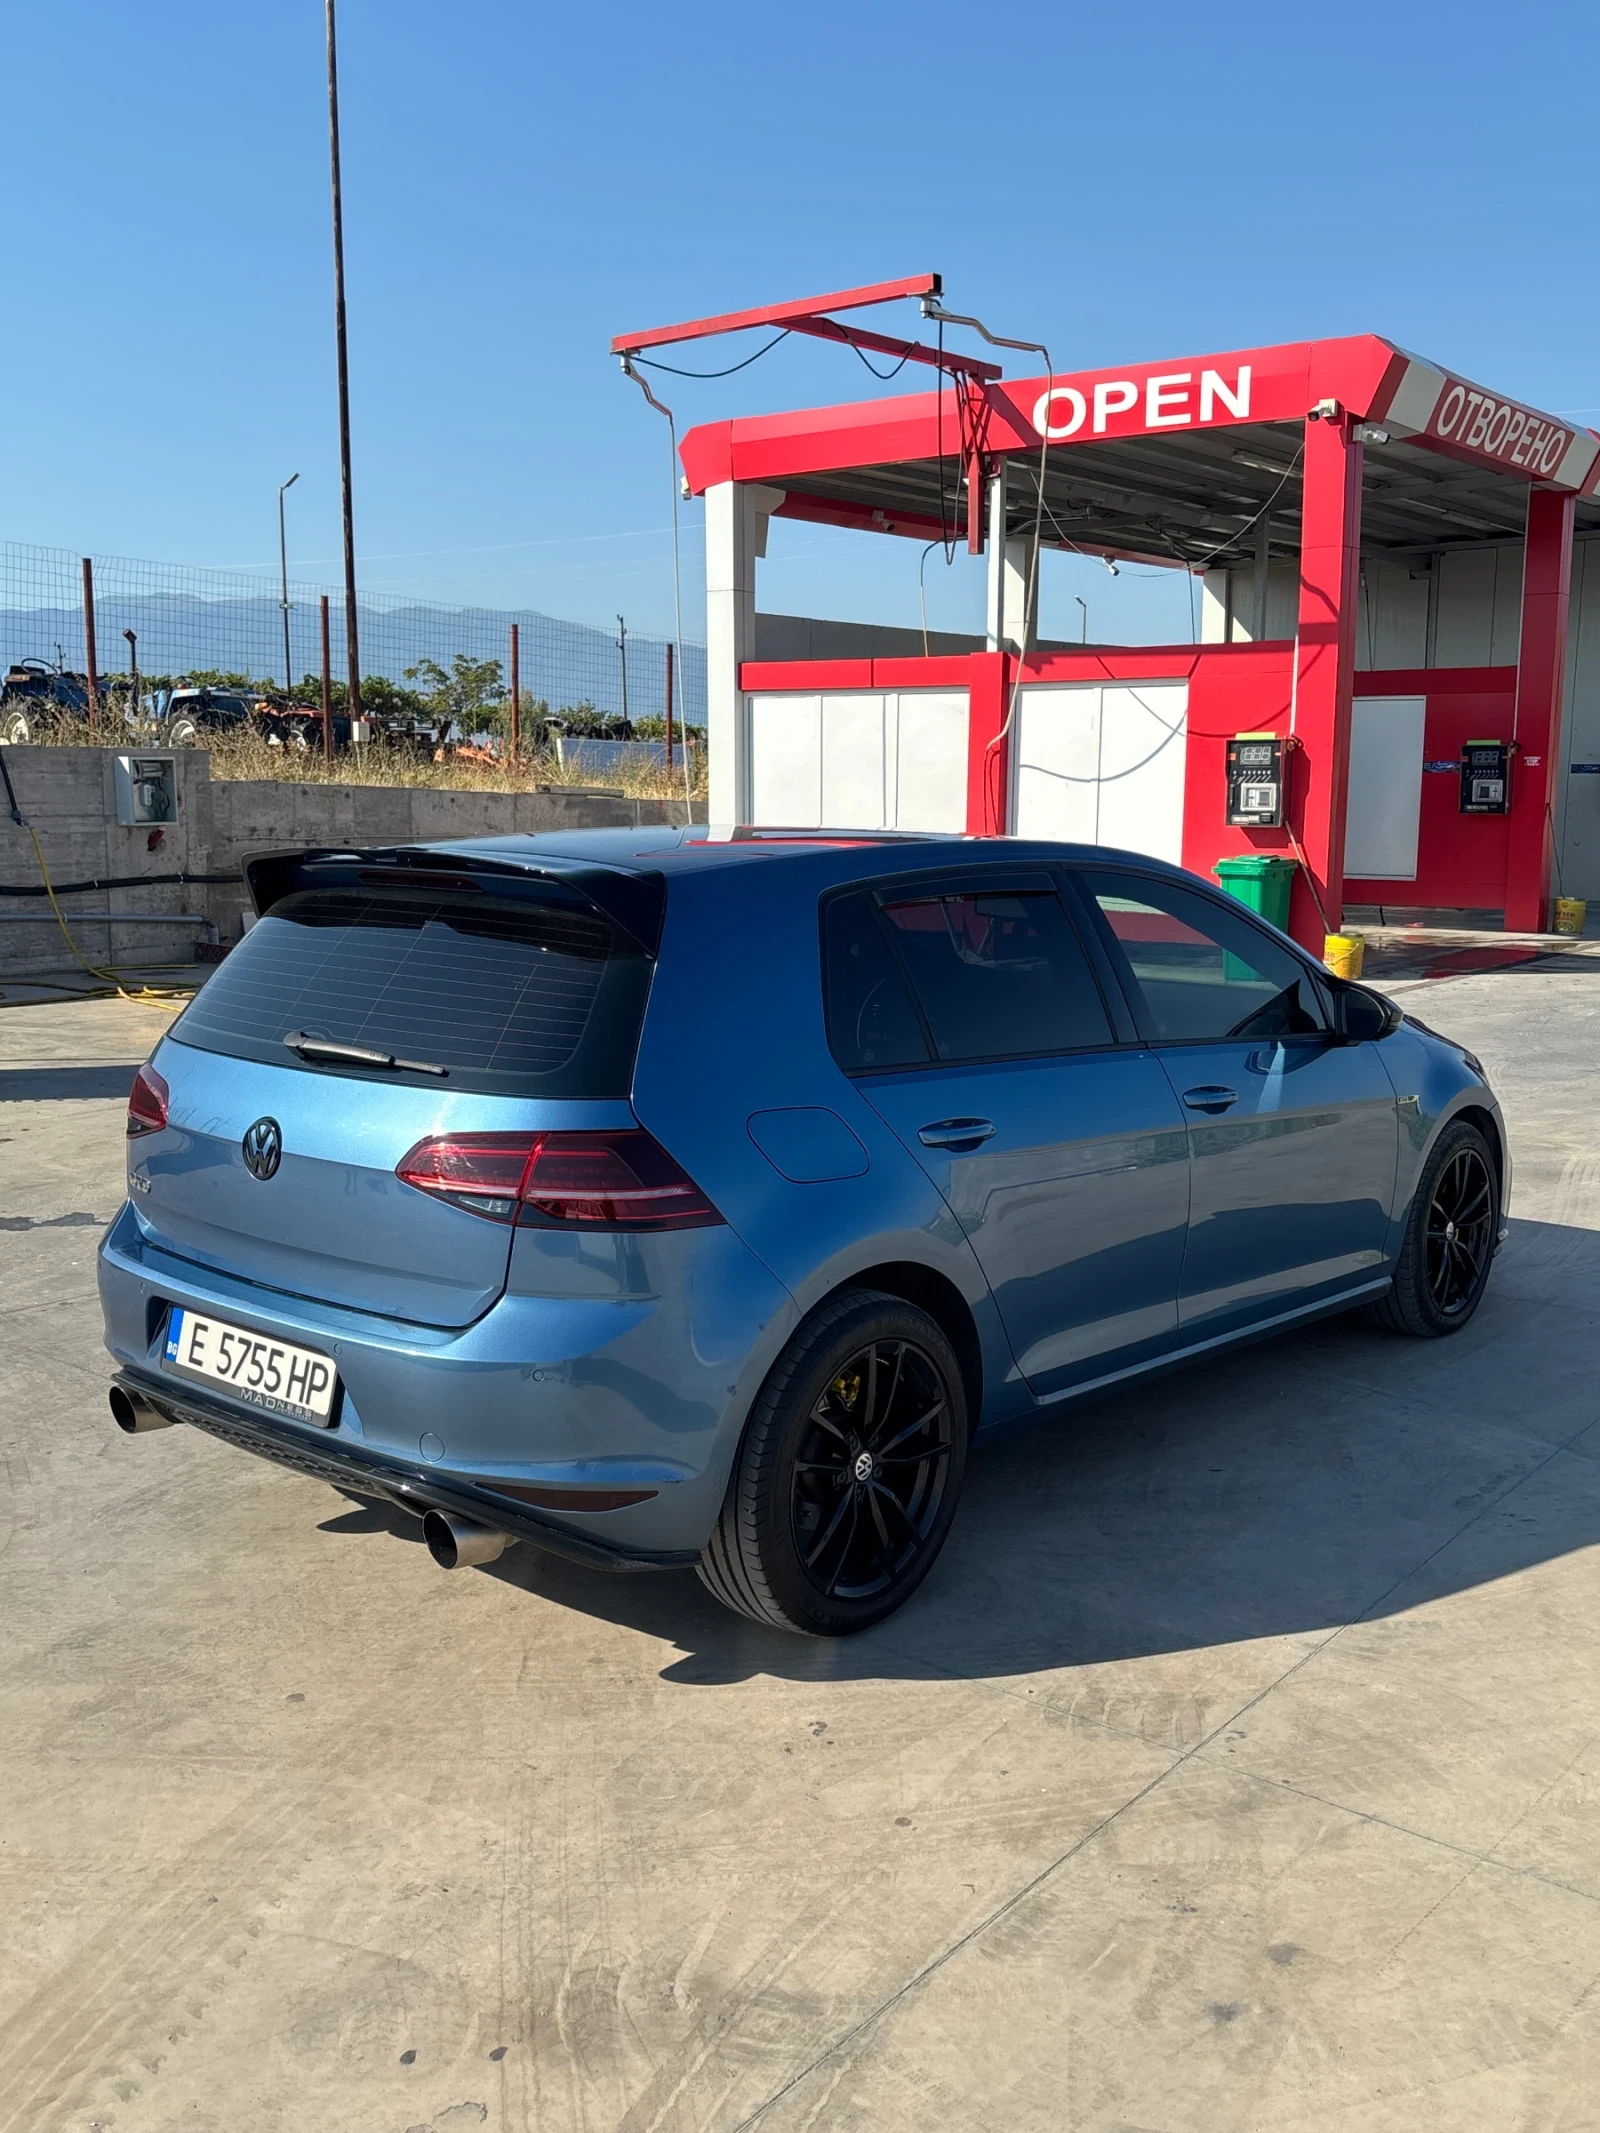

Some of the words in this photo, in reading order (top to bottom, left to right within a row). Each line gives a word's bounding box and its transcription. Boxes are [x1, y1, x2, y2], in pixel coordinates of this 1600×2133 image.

[1031, 365, 1253, 439] OPEN
[1437, 385, 1567, 474] ОТВОРЕНО
[166, 1340, 178, 1356] BG
[188, 1321, 209, 1367] E
[216, 1331, 285, 1393] 5755
[285, 1354, 330, 1406] HP
[240, 1387, 313, 1418] MADNESS
